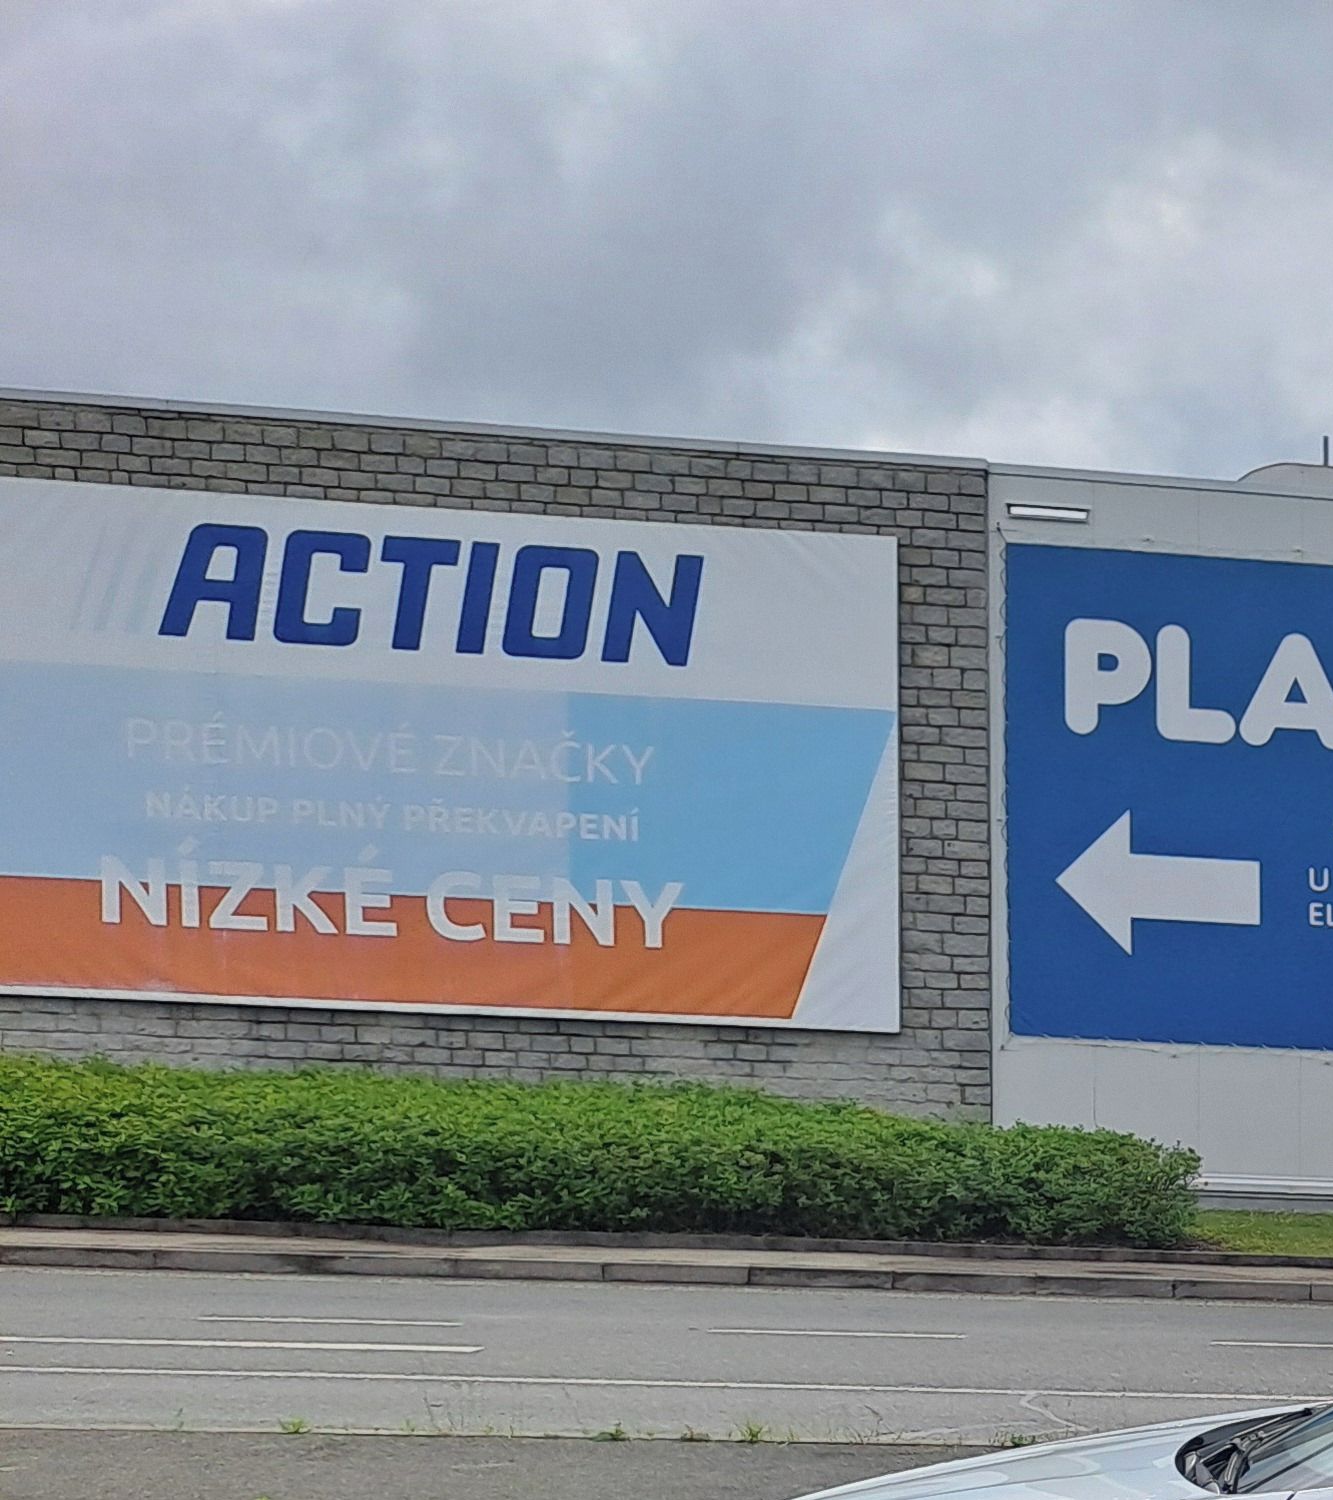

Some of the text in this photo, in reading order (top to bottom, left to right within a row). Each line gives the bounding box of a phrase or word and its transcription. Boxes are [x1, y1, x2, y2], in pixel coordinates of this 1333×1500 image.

[158, 522, 704, 667] ACTION
[125, 712, 655, 786] PRÉMIOVÉ ZNAČKY
[145, 786, 640, 841] NÁKUP PLNÝ PŘEKVAPENÍ
[99, 837, 685, 949] NÍZKÉ CENY
[1308, 868, 1330, 892] U
